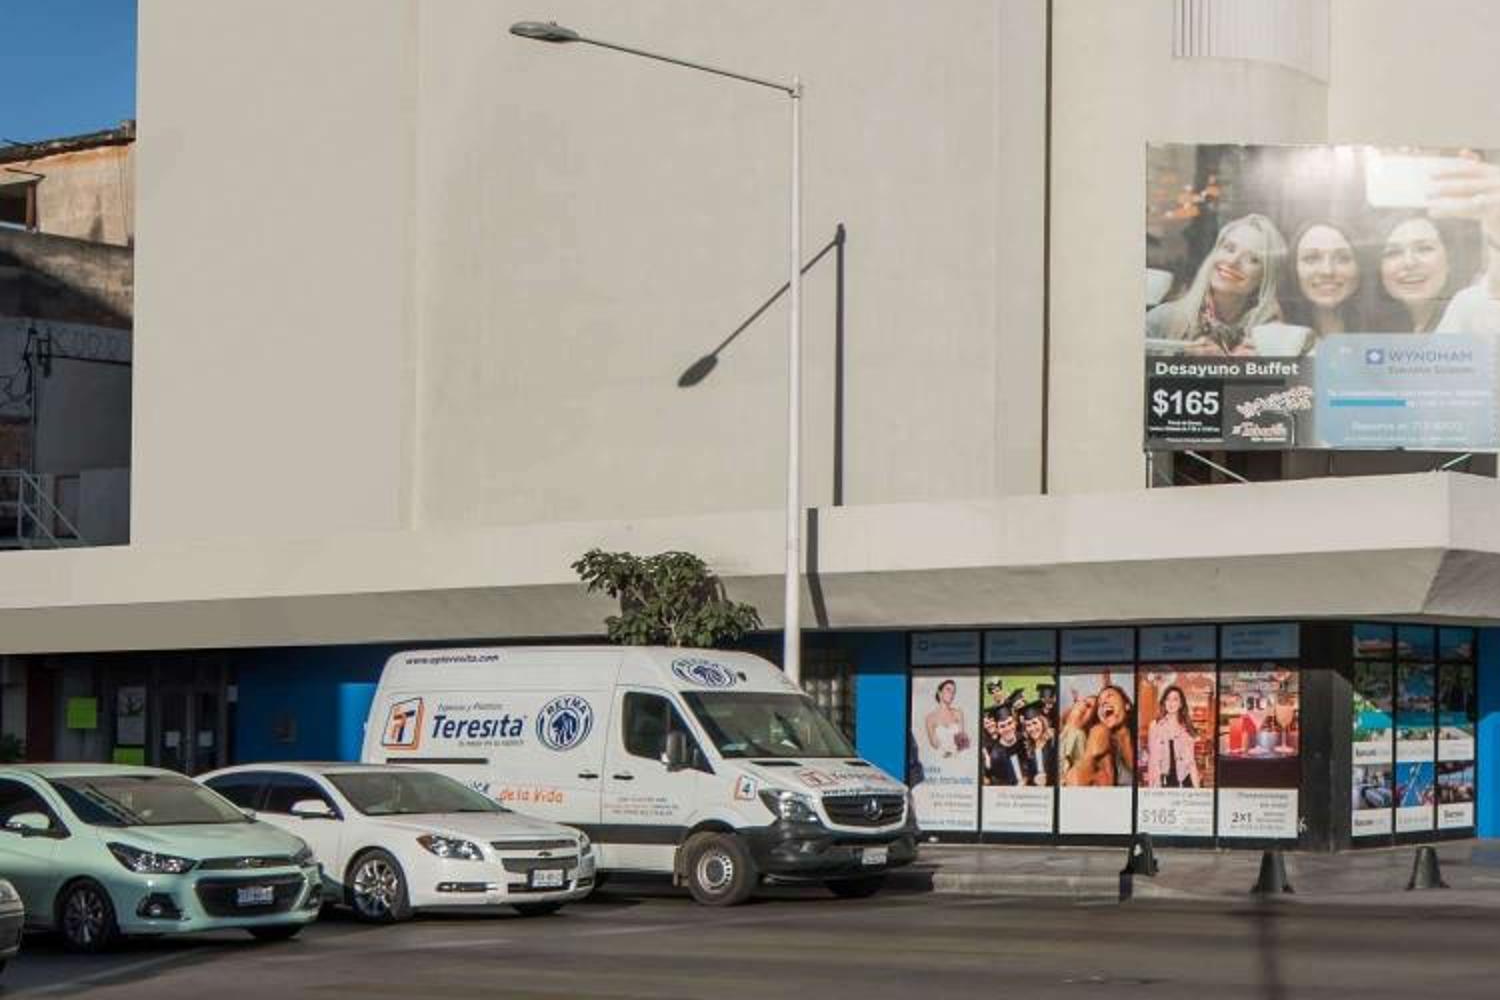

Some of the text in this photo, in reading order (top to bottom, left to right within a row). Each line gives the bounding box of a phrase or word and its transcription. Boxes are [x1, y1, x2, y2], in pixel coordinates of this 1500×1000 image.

[1389, 349, 1473, 363] WYNDHAM
[1155, 360, 1299, 379] Desayuno Buffet
[1152, 388, 1220, 417] $165
[546, 697, 587, 716] REYMA
[431, 713, 524, 739] Teresita
